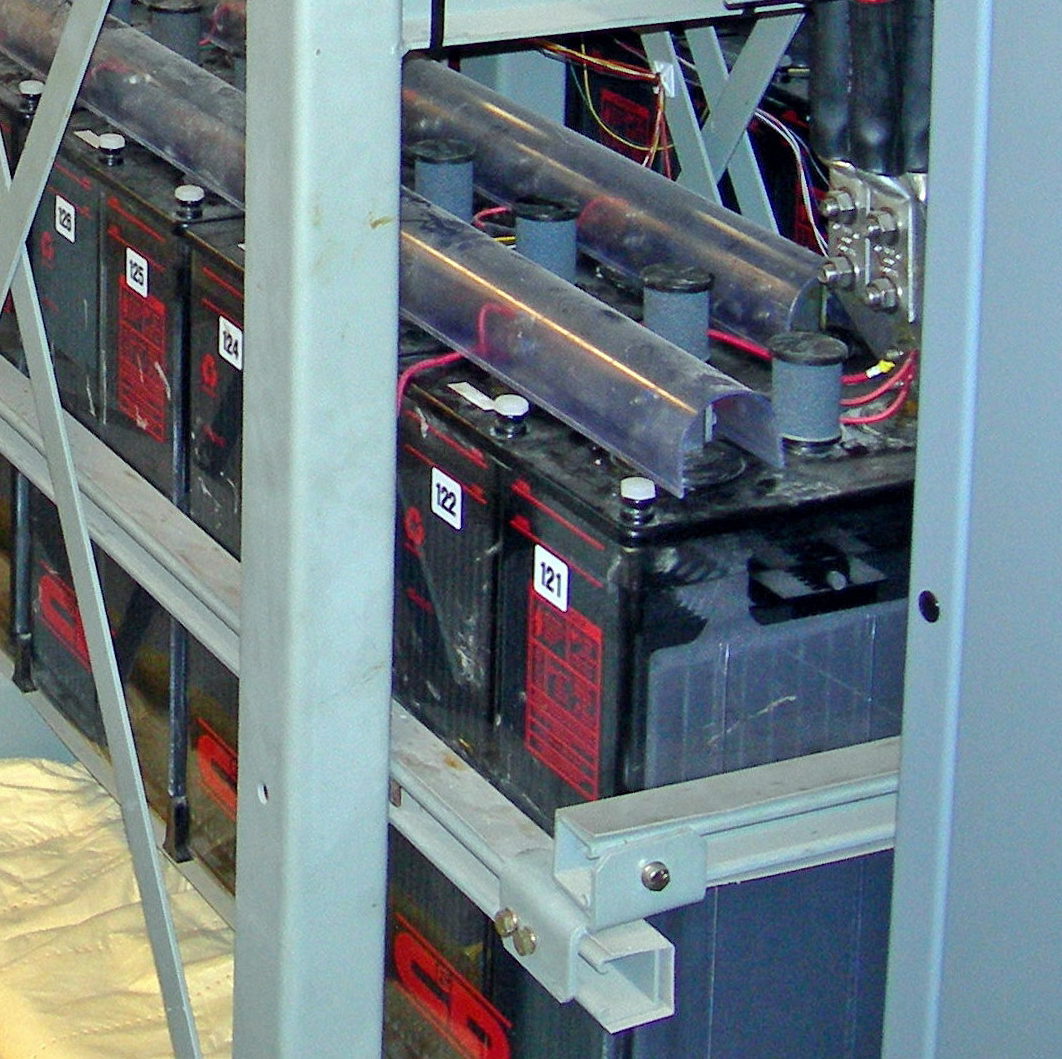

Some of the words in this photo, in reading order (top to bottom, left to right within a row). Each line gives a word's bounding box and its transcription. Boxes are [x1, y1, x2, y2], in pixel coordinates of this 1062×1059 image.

[58, 207, 71, 232] 126
[129, 259, 145, 287] 125
[223, 331, 239, 360] 124
[436, 483, 457, 517] 122
[541, 562, 562, 598] 121
